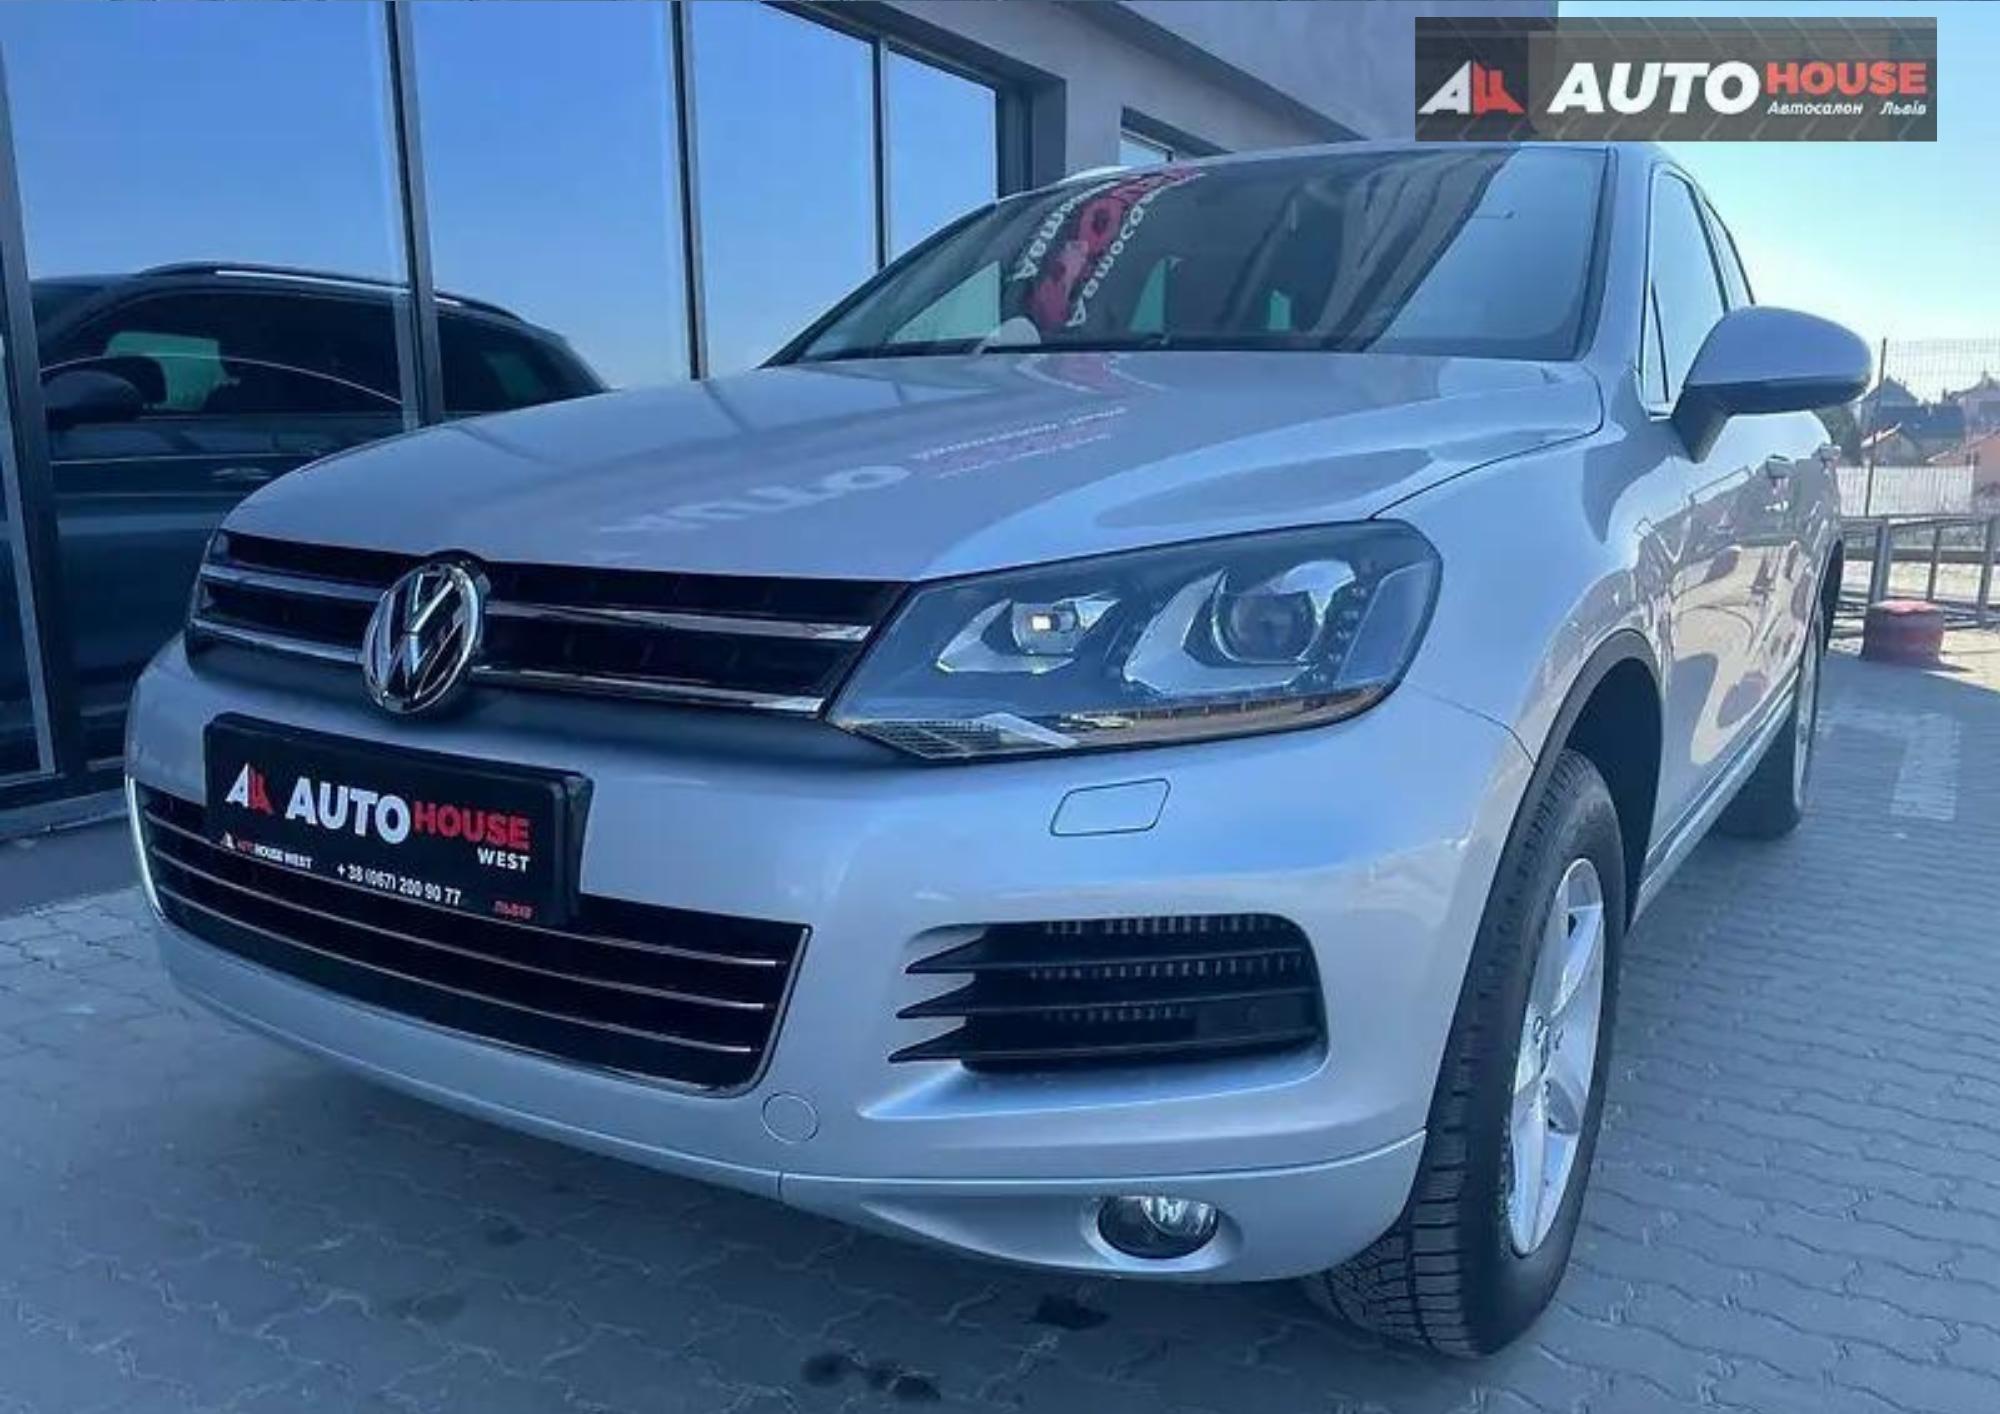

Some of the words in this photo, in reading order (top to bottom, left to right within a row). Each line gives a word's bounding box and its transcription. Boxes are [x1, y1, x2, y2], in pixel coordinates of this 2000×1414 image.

[285, 776, 411, 844] AUTO
[413, 801, 531, 850] HOUSE
[477, 847, 531, 873] WEST
[399, 877, 423, 897] 200
[444, 888, 461, 906] 77
